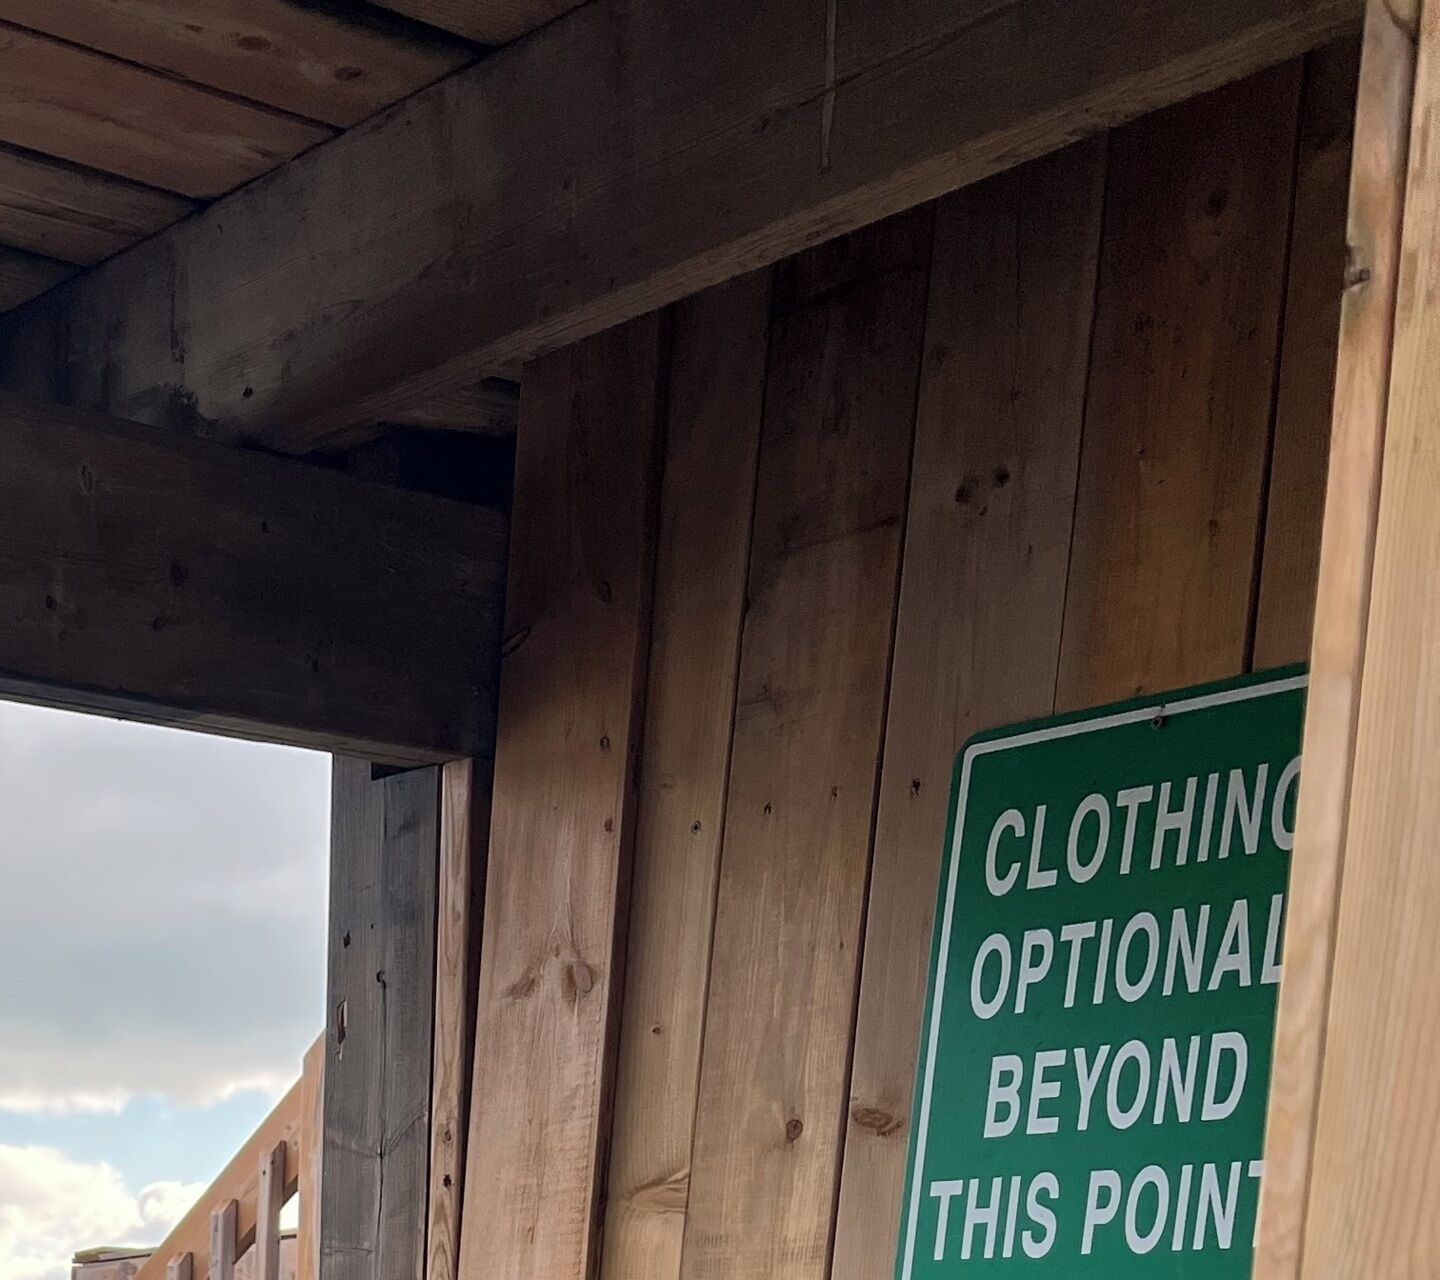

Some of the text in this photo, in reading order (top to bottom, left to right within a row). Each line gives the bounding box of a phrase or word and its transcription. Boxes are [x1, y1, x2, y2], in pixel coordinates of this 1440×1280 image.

[970, 893, 1284, 1020] OPTIONAL
[984, 1031, 1248, 1138] BEYOND
[930, 1171, 1059, 1261] THIS
